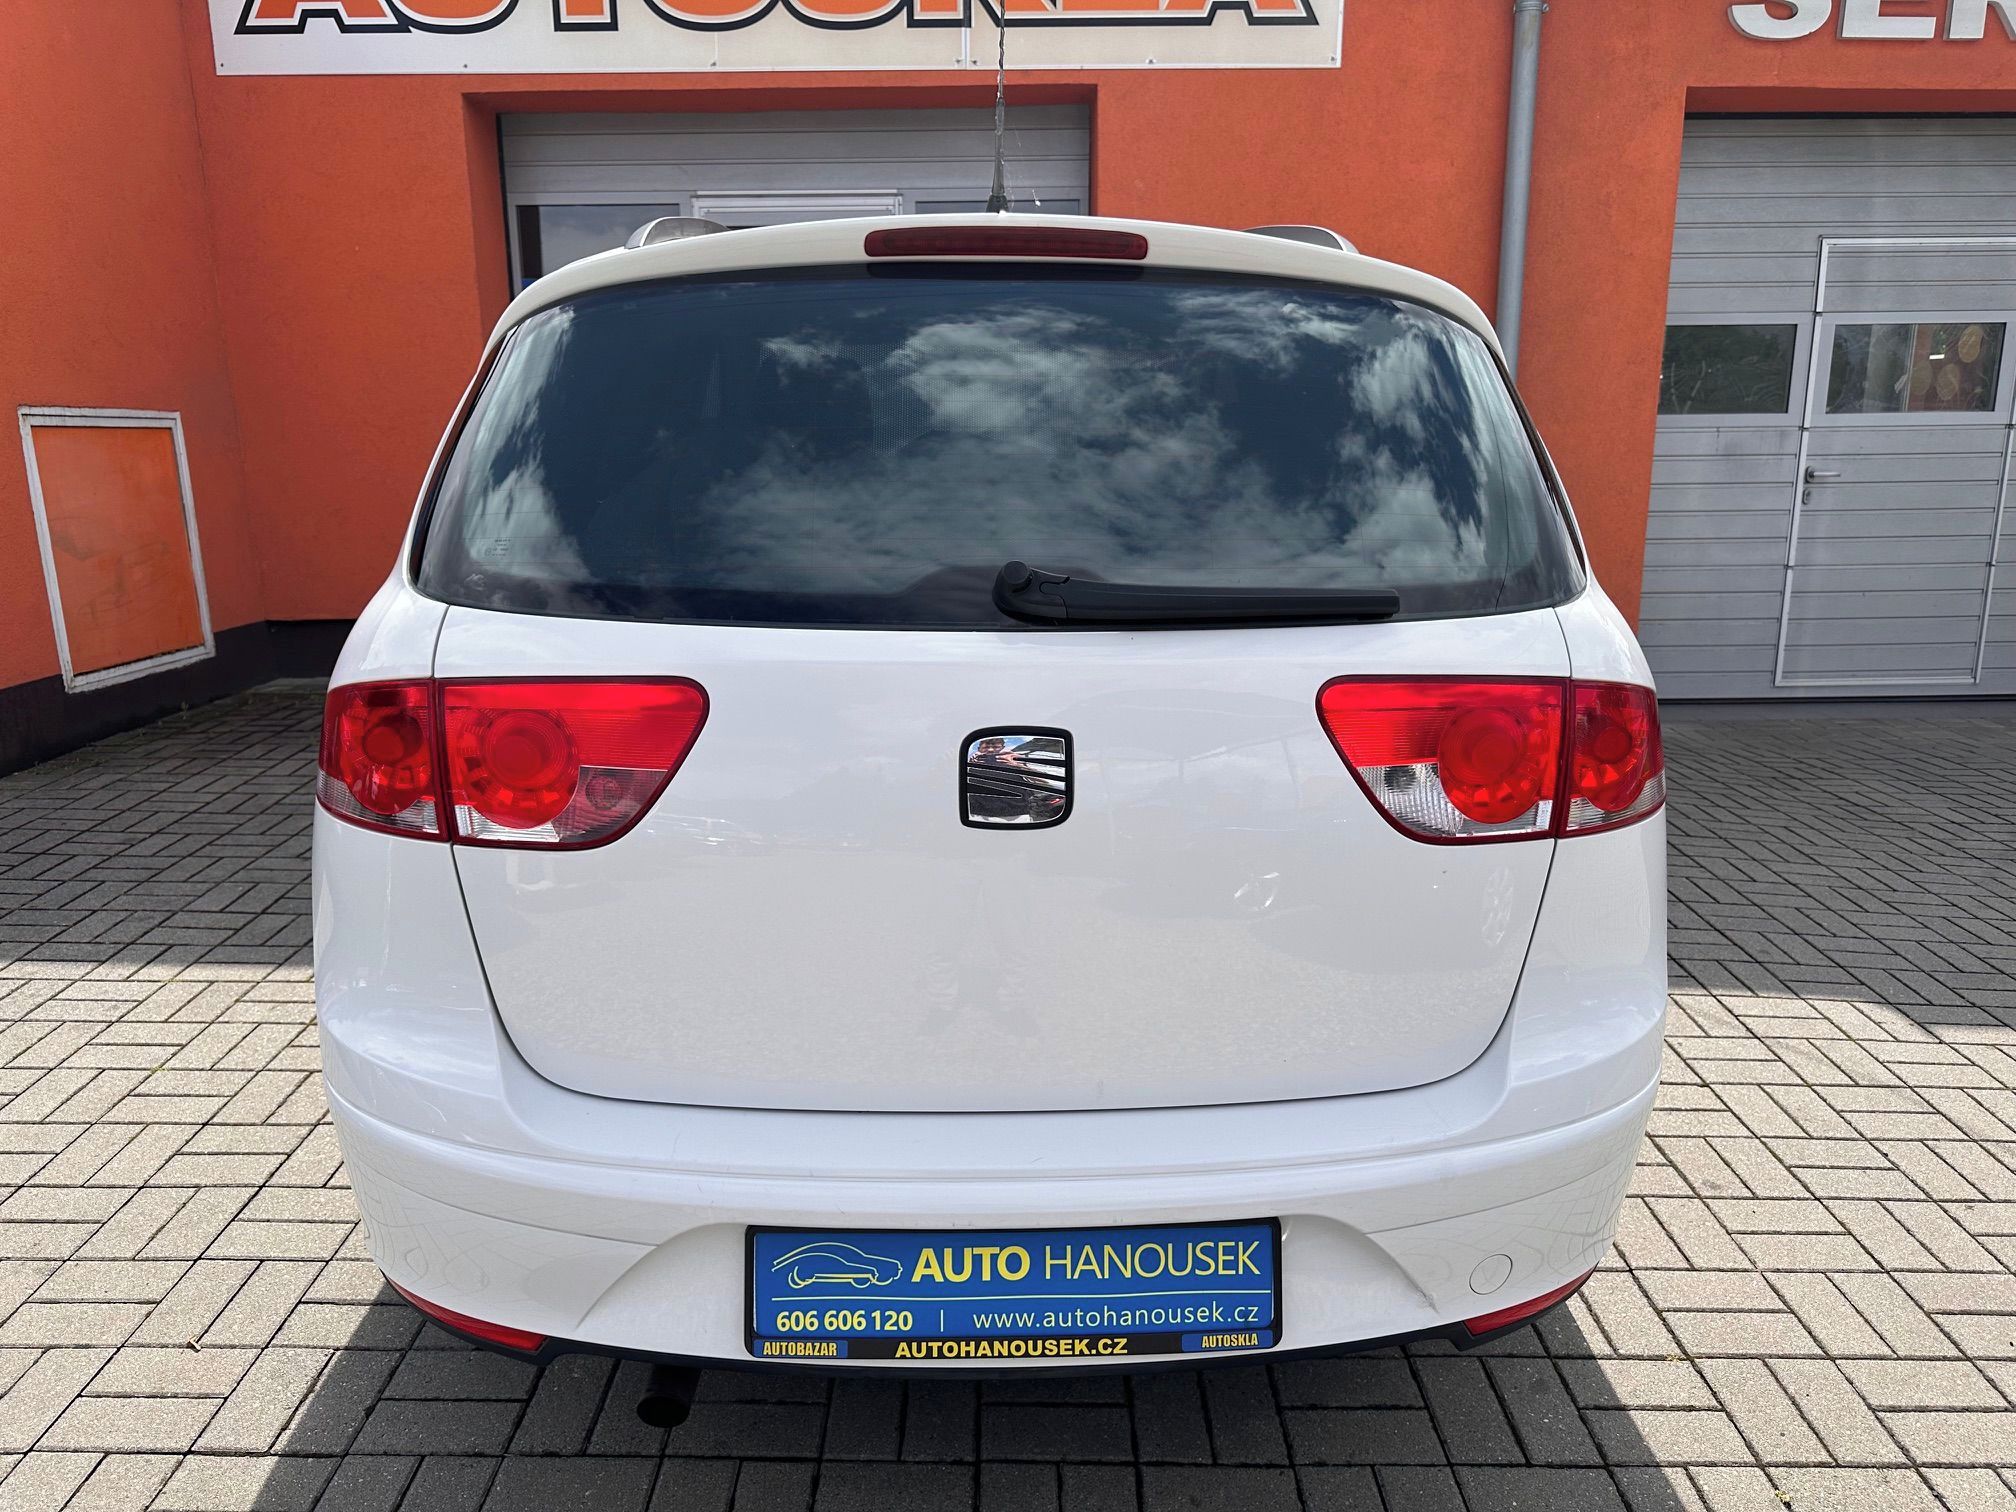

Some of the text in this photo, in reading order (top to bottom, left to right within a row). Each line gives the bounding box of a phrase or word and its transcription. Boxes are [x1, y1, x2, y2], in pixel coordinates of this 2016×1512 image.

[911, 1240, 1261, 1283] AUTO HANOUSEK
[776, 1300, 1259, 1332] 606 606 120 www.autohanousek.cz
[763, 1341, 837, 1356] AUTOBAZAR
[895, 1338, 1128, 1358] AUTOHANOUSEK.CZ
[1201, 1332, 1259, 1348] AUTOSKLA
